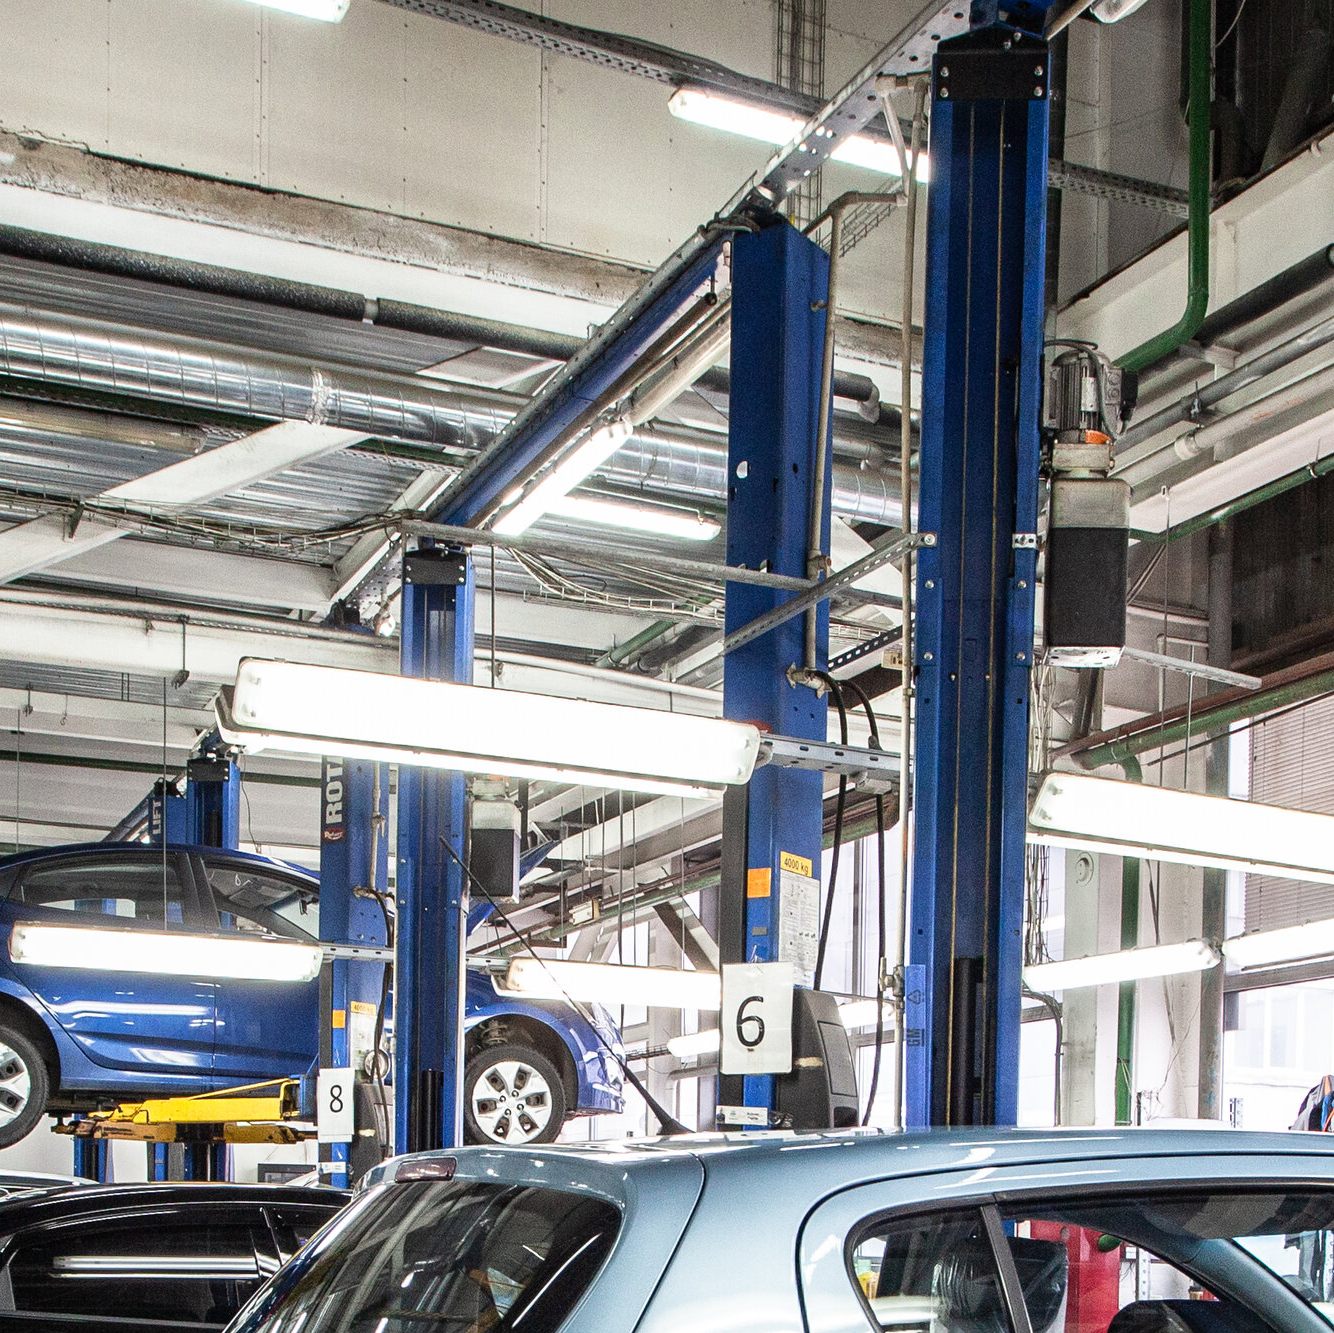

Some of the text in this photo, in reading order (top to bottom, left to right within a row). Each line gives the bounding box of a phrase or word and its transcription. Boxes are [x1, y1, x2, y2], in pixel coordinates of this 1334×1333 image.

[152, 799, 162, 835] LIFT
[784, 857, 809, 875] 4000 kg
[736, 995, 766, 1048] 6
[329, 1084, 344, 1113] 8
